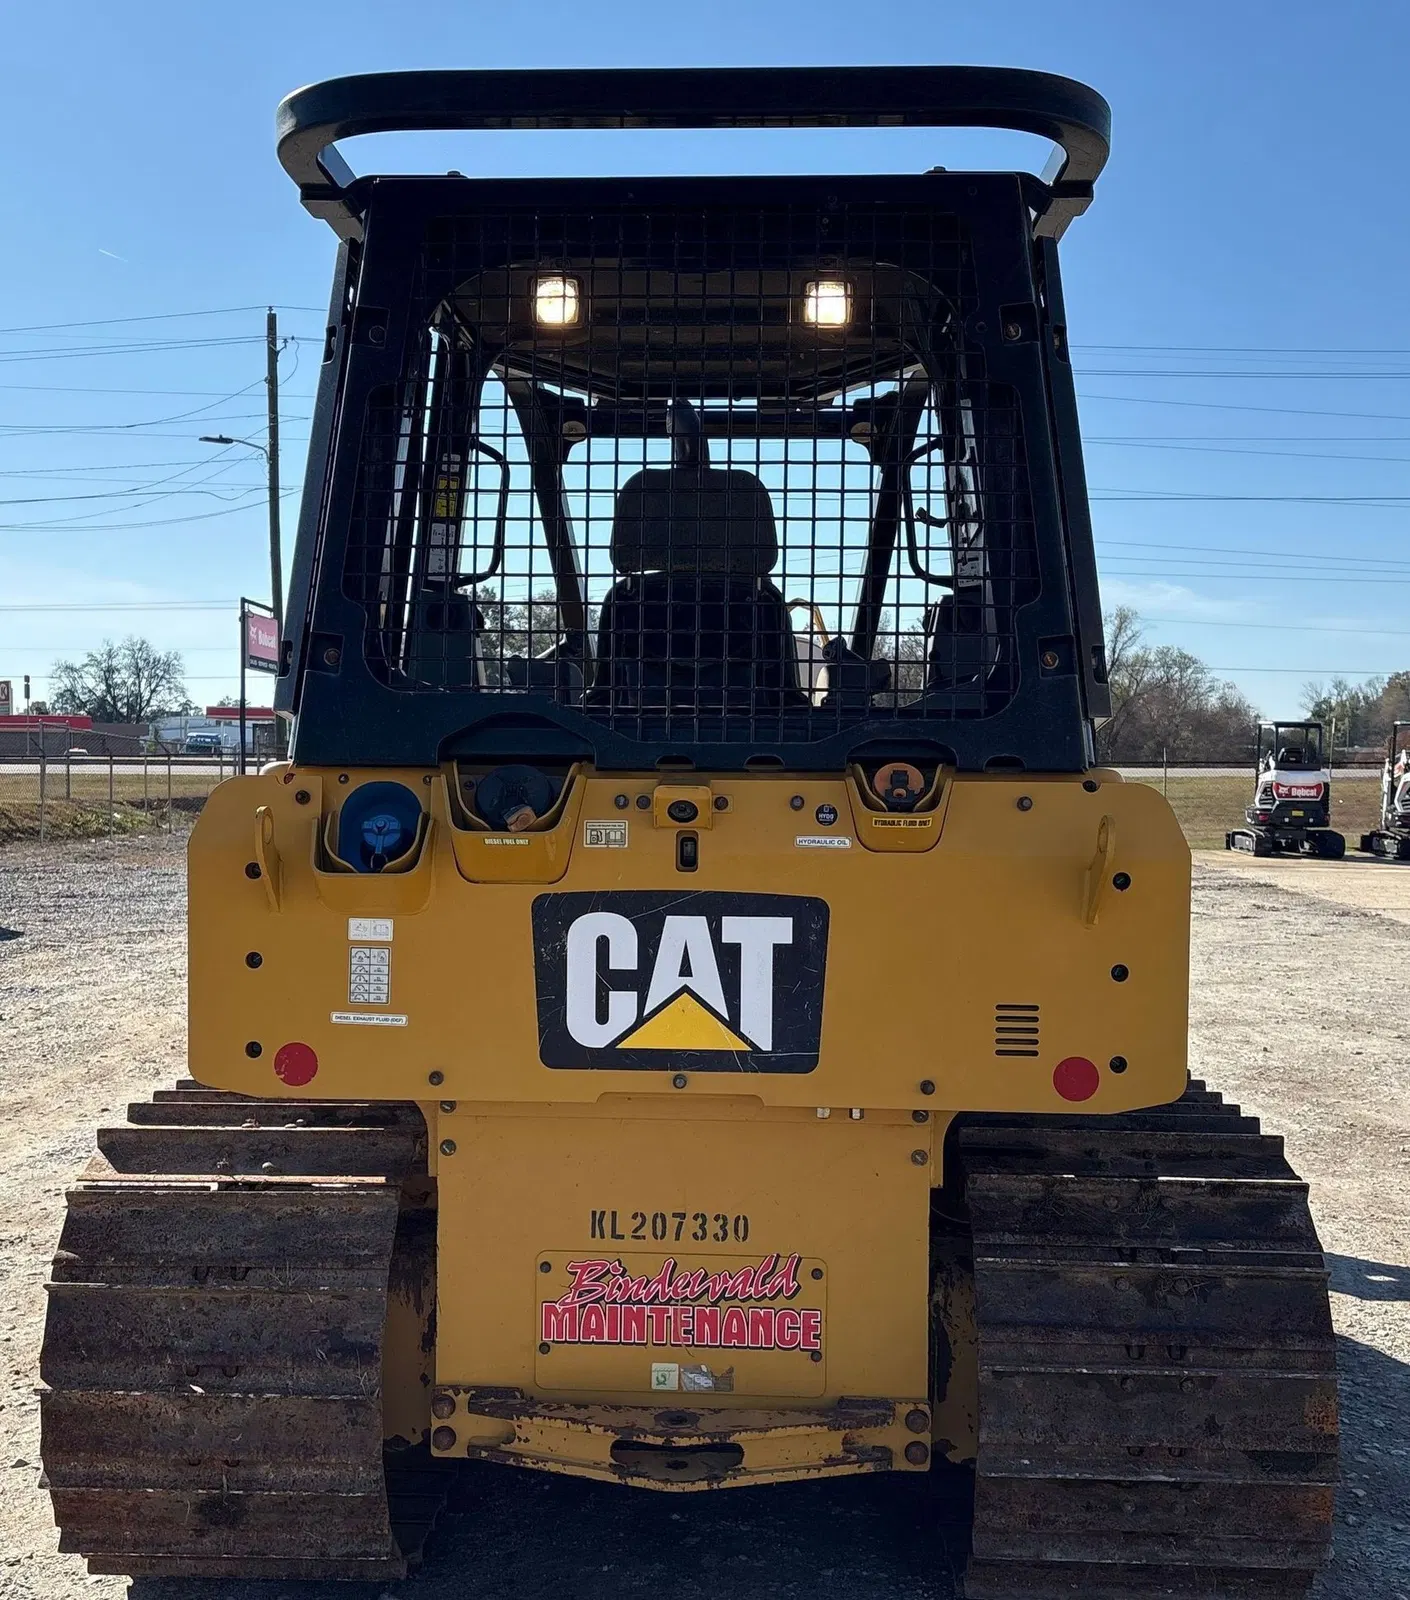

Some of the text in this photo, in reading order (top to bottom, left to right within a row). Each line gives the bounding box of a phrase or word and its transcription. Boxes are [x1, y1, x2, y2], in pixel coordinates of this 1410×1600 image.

[258, 630, 276, 648] Bobcat
[1291, 787, 1317, 797] Bobcat
[798, 838, 836, 846] HYDRAULIC
[566, 911, 794, 1052] CAT
[589, 1209, 750, 1243] KL207330
[558, 1253, 801, 1307] Bindewald
[541, 1302, 822, 1351] MAINTENANCE
